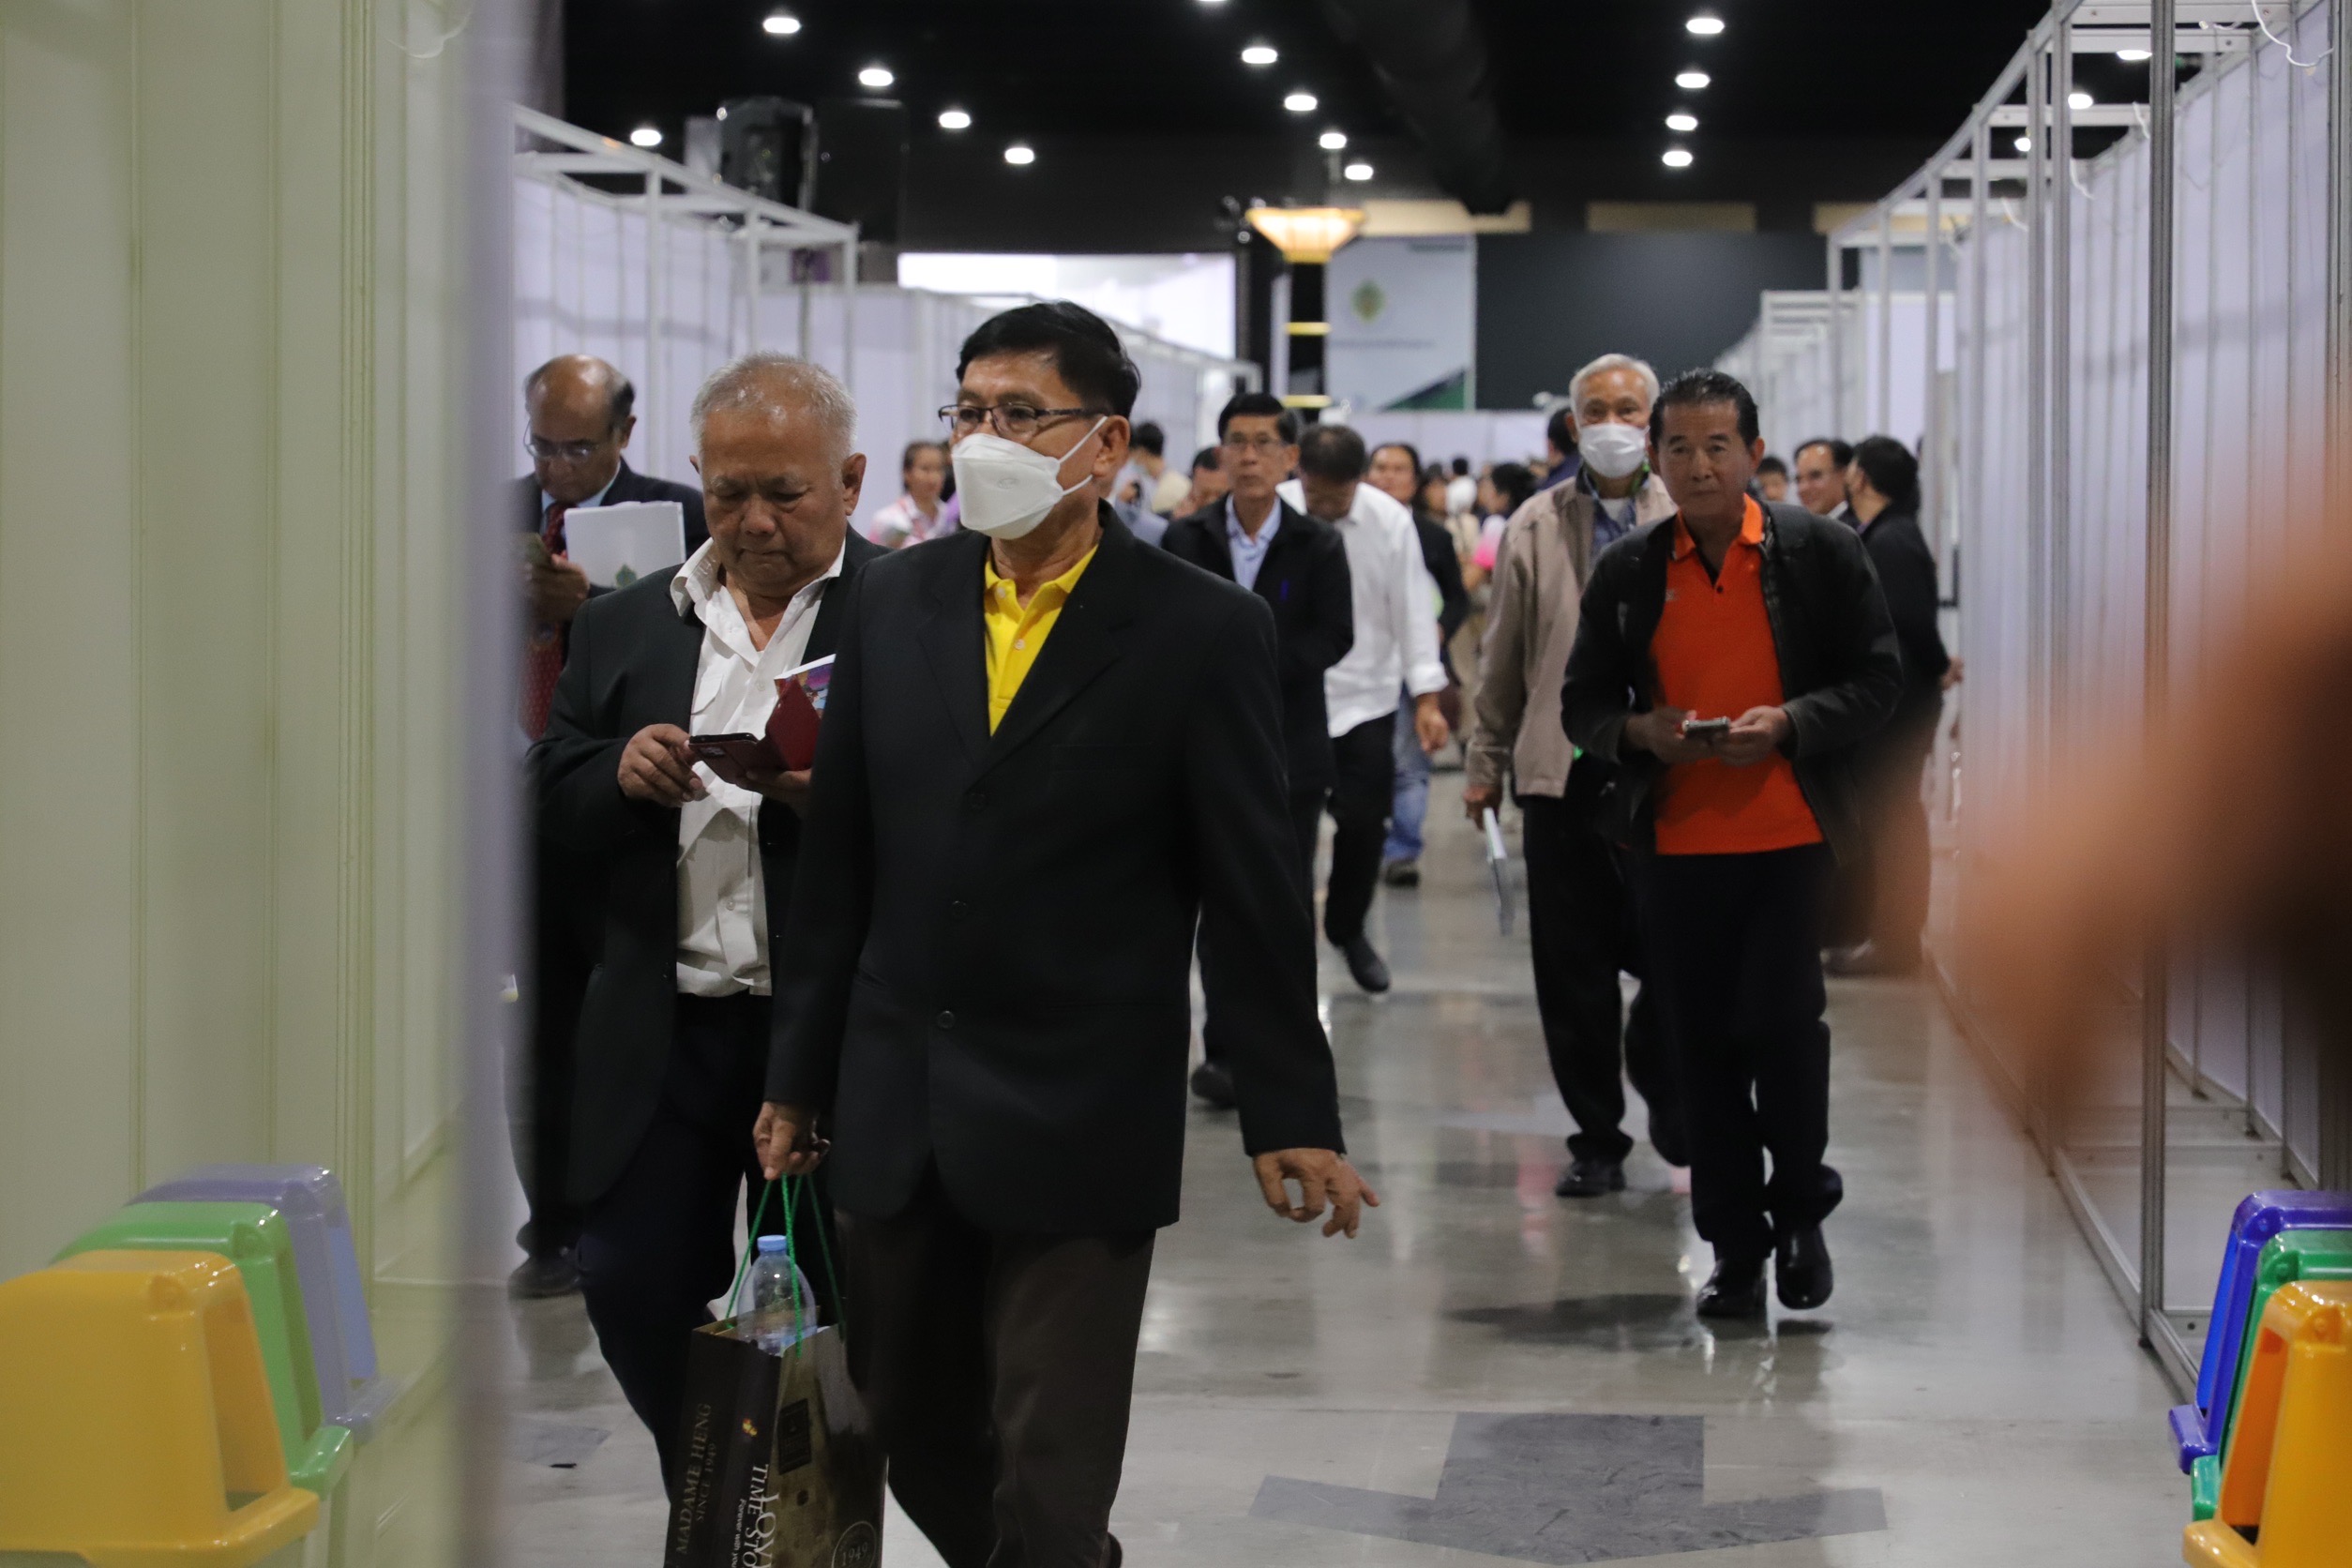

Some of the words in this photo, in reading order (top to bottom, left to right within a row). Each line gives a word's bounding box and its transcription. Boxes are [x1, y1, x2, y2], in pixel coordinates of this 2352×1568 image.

[676, 1465, 701, 1554] MADAME
[691, 1402, 711, 1459] HENG
[748, 1464, 769, 1515] TIME
[736, 1499, 746, 1532] Forever
[742, 1527, 761, 1568] STO
[840, 1542, 867, 1567] 1949
